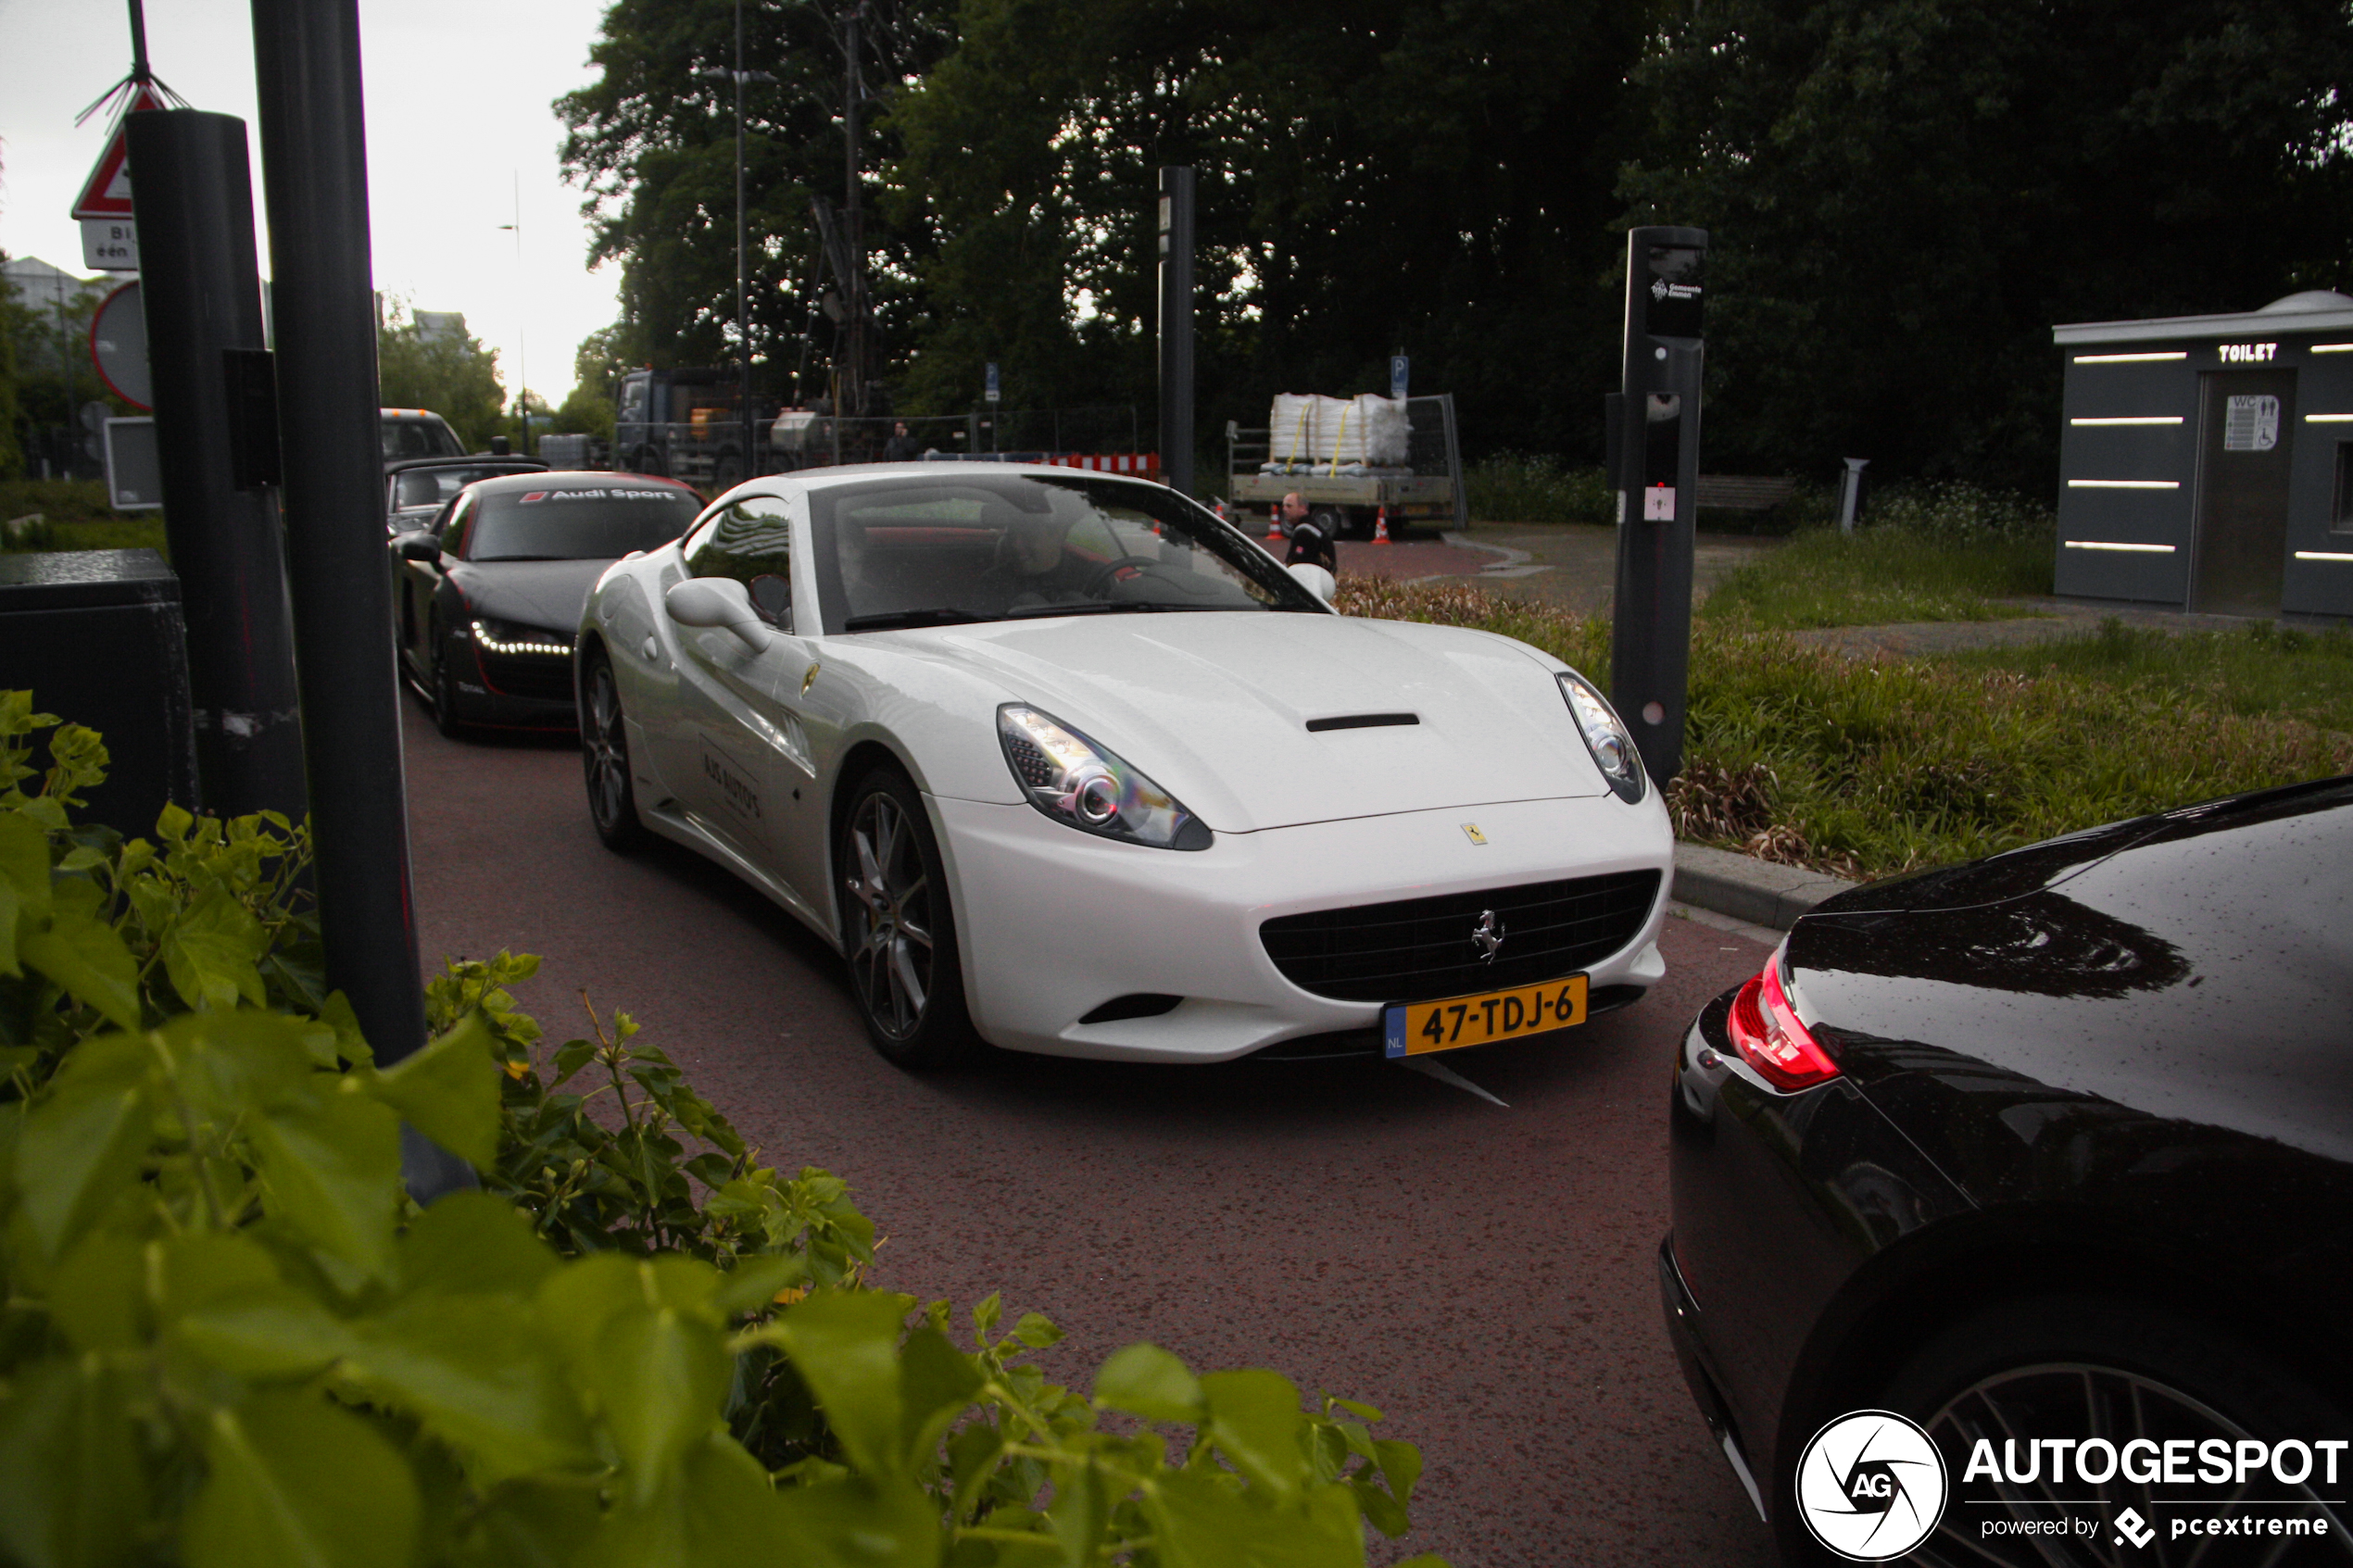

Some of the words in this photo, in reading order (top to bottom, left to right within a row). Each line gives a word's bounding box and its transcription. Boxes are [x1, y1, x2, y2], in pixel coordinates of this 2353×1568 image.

[1667, 290, 1692, 298] Emmen
[1668, 282, 1703, 294] Gemeente
[2219, 343, 2278, 363] TOILET
[1395, 359, 1404, 376] P
[2233, 395, 2257, 408] WC
[551, 489, 606, 499] Audi
[610, 489, 675, 500] Sport
[1422, 985, 1574, 1045] 47-TDJ-6
[1388, 1037, 1403, 1048] NL
